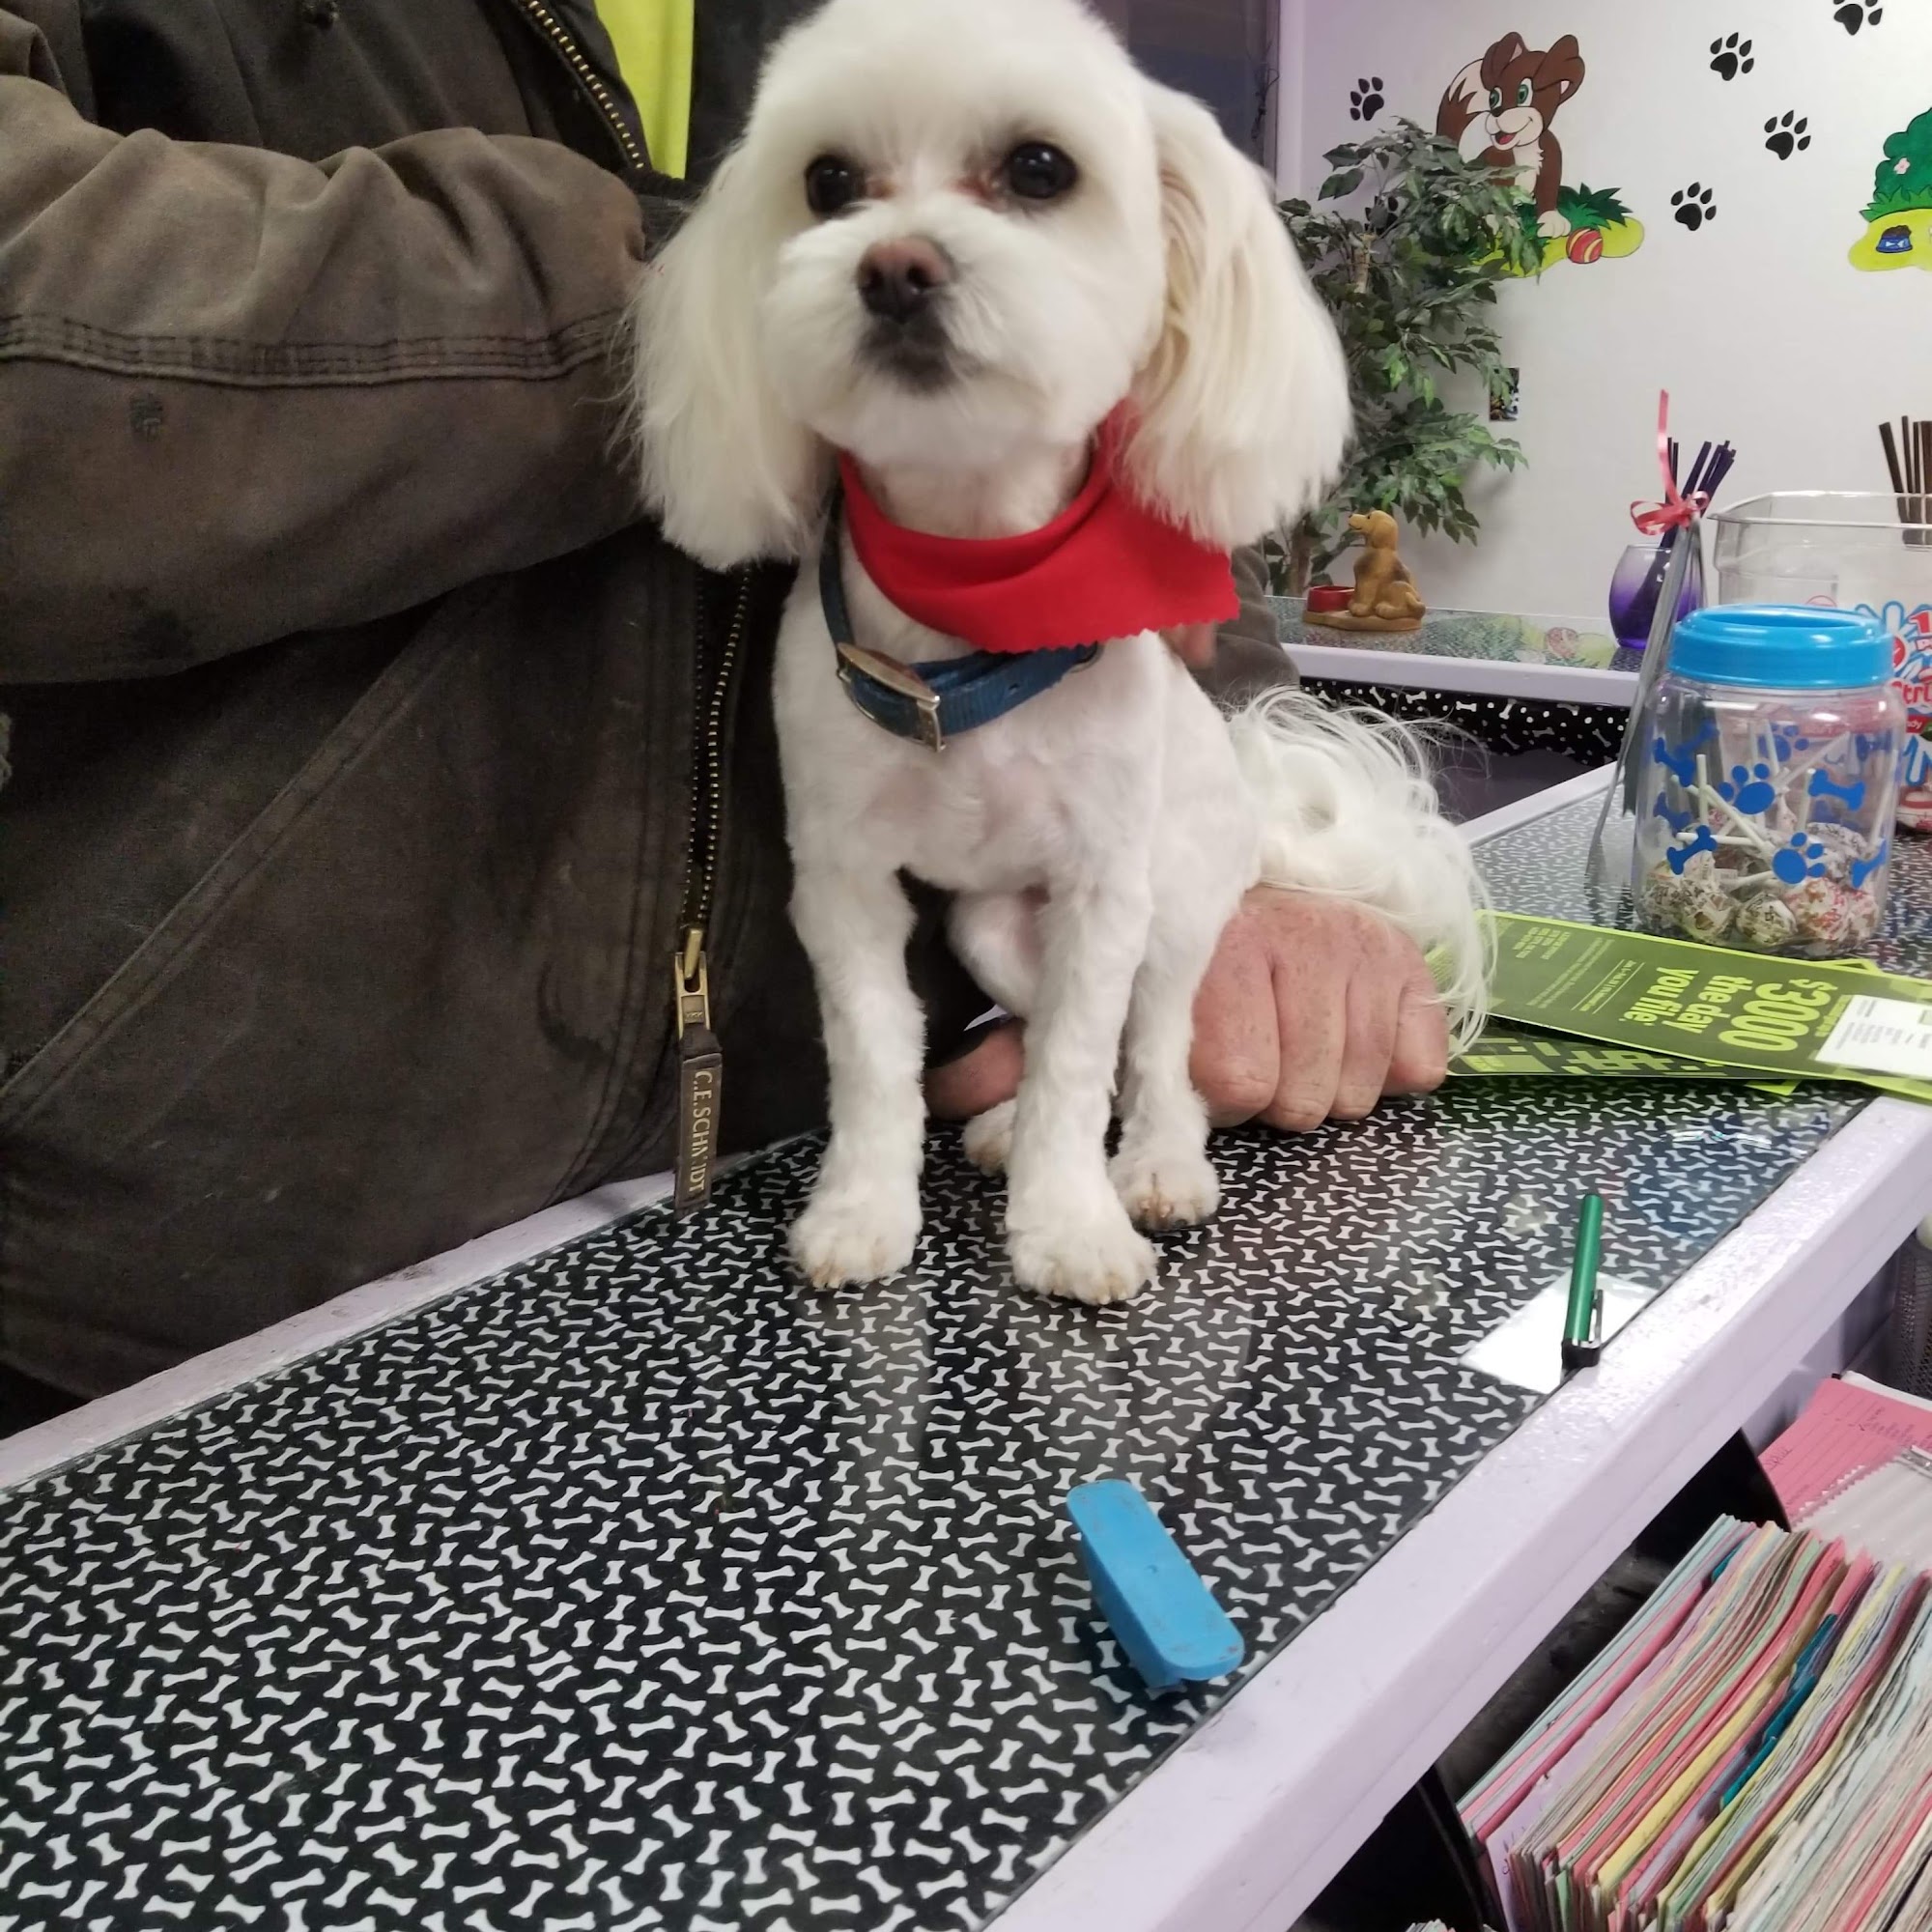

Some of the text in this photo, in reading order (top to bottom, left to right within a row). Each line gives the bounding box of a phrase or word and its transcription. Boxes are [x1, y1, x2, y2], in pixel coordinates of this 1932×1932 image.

[1646, 966, 1700, 999] you
[1661, 975, 1754, 1034] the day
[1718, 979, 1838, 1052] $3000
